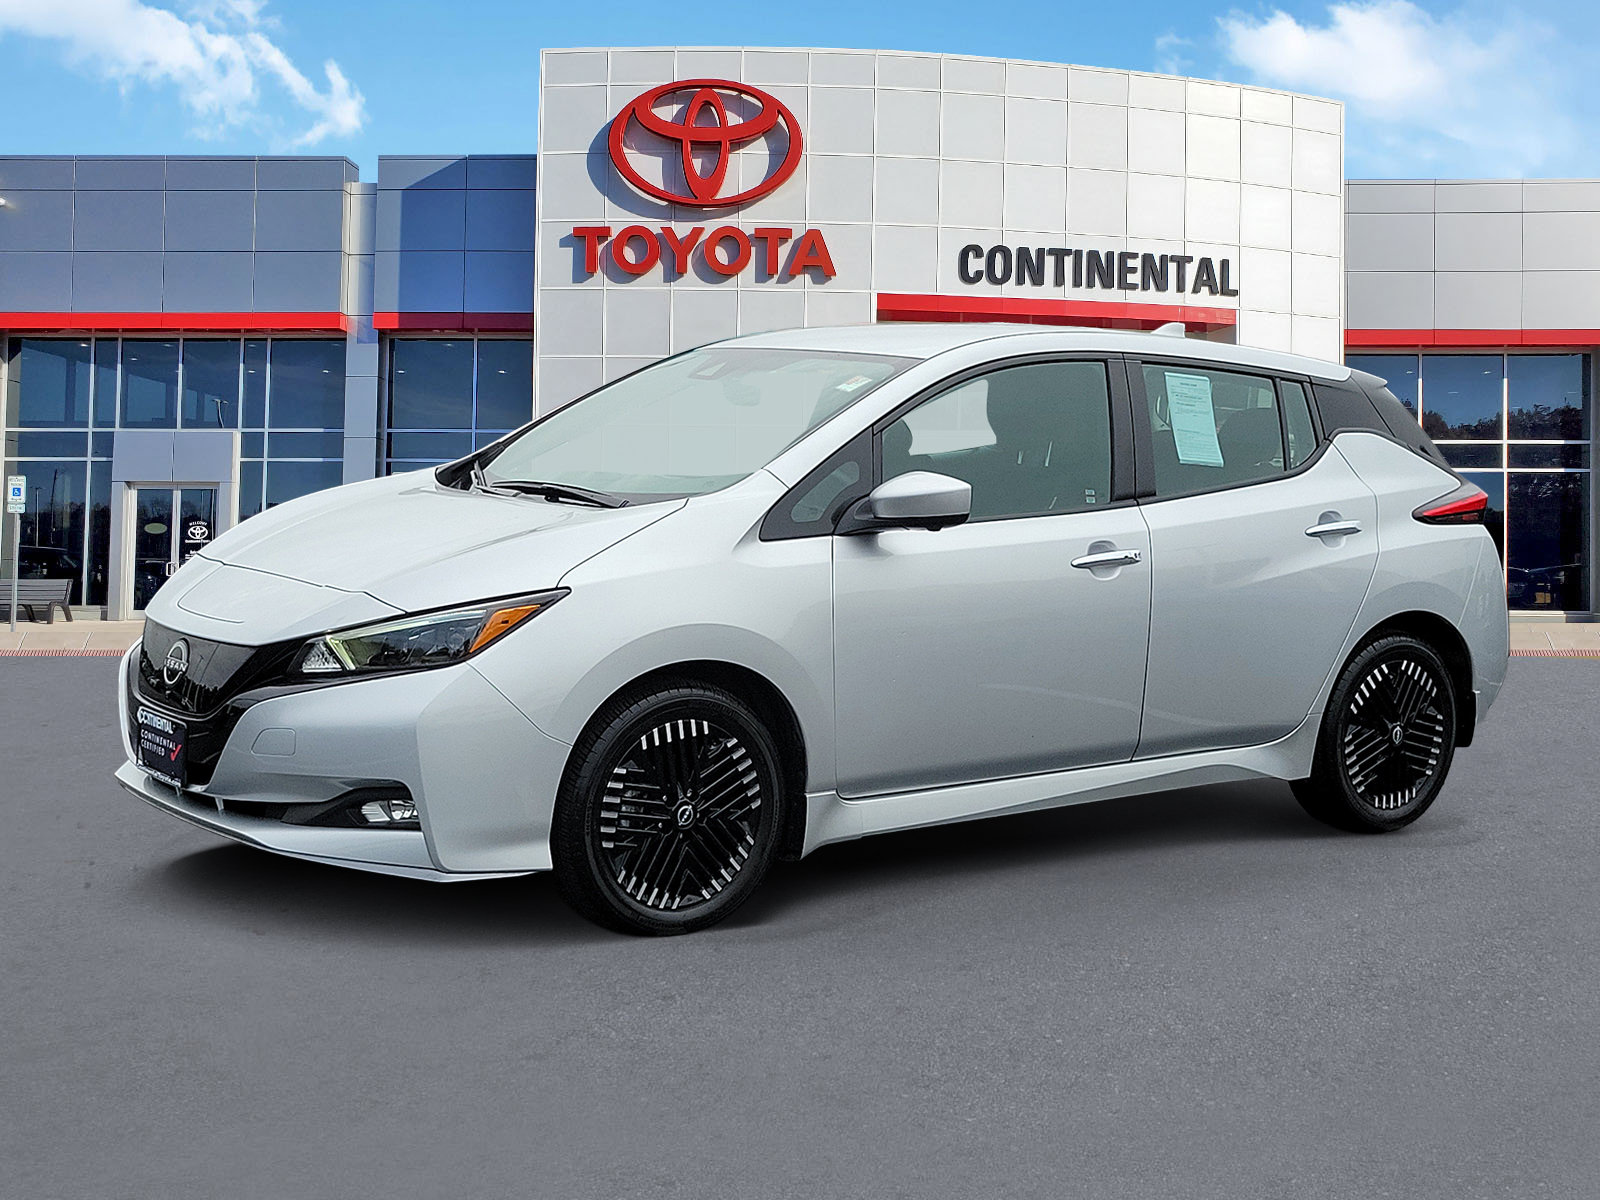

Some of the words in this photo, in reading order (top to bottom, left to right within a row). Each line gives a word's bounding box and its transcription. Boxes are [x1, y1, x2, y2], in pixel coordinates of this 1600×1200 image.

[572, 225, 837, 277] TOYOTA
[958, 244, 1239, 297] CONTINENTAL
[140, 729, 176, 751] CONTINENTAL
[140, 739, 165, 757] CERTIFIED
